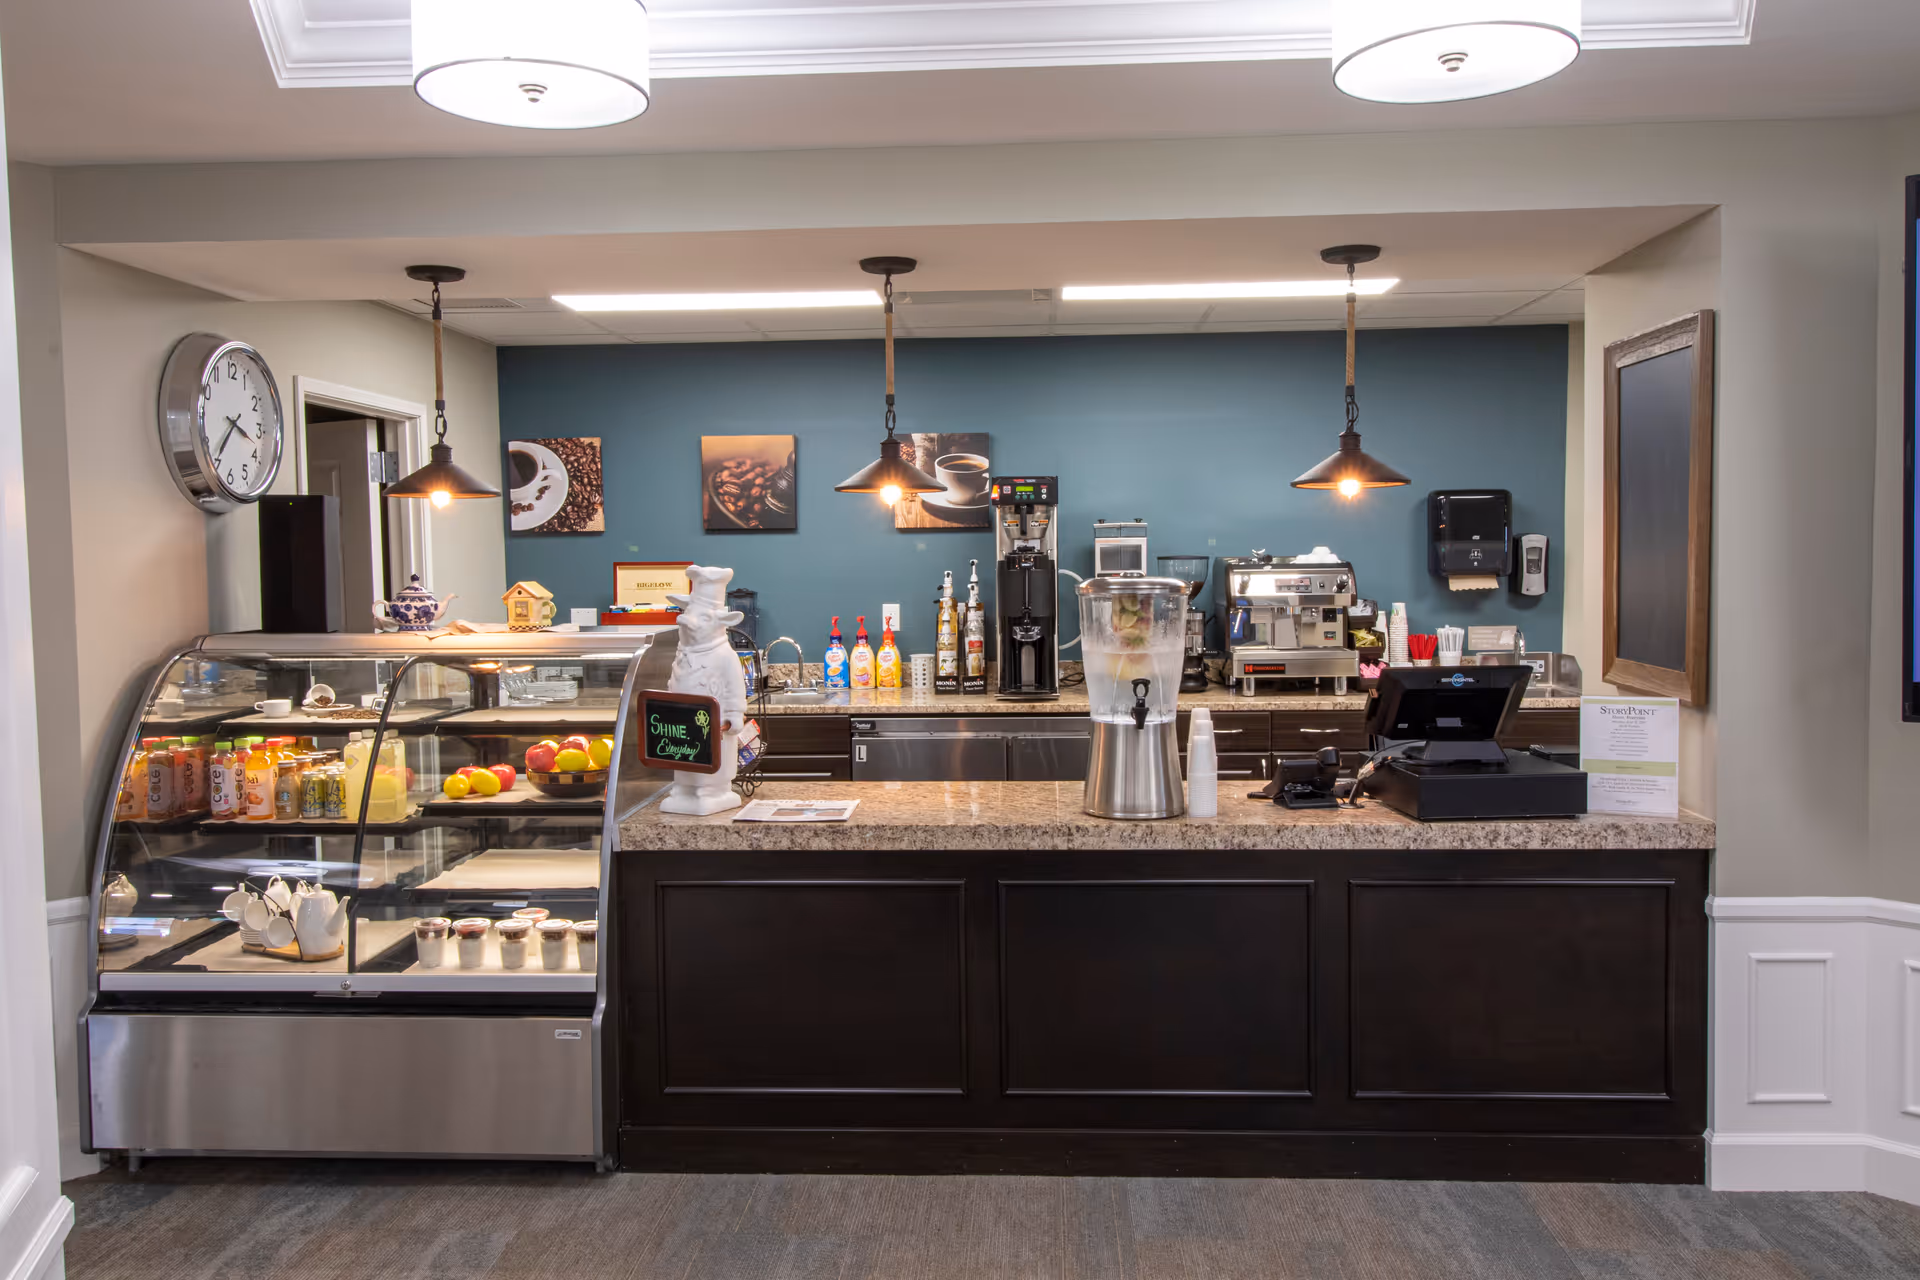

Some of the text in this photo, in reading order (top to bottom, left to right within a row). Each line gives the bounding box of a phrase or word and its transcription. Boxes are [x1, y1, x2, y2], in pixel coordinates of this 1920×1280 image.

[213, 365, 219, 384] 11
[228, 361, 237, 380] 12
[243, 374, 246, 391] 1
[251, 395, 258, 412] 2
[256, 422, 262, 439] 3
[251, 447, 258, 462] 4
[214, 457, 221, 470] 7
[227, 468, 234, 485] 6
[241, 464, 248, 481] 5
[964, 679, 984, 687] MONIN
[657, 738, 700, 760] Everyday
[212, 769, 222, 803] core
[235, 767, 243, 801] core
